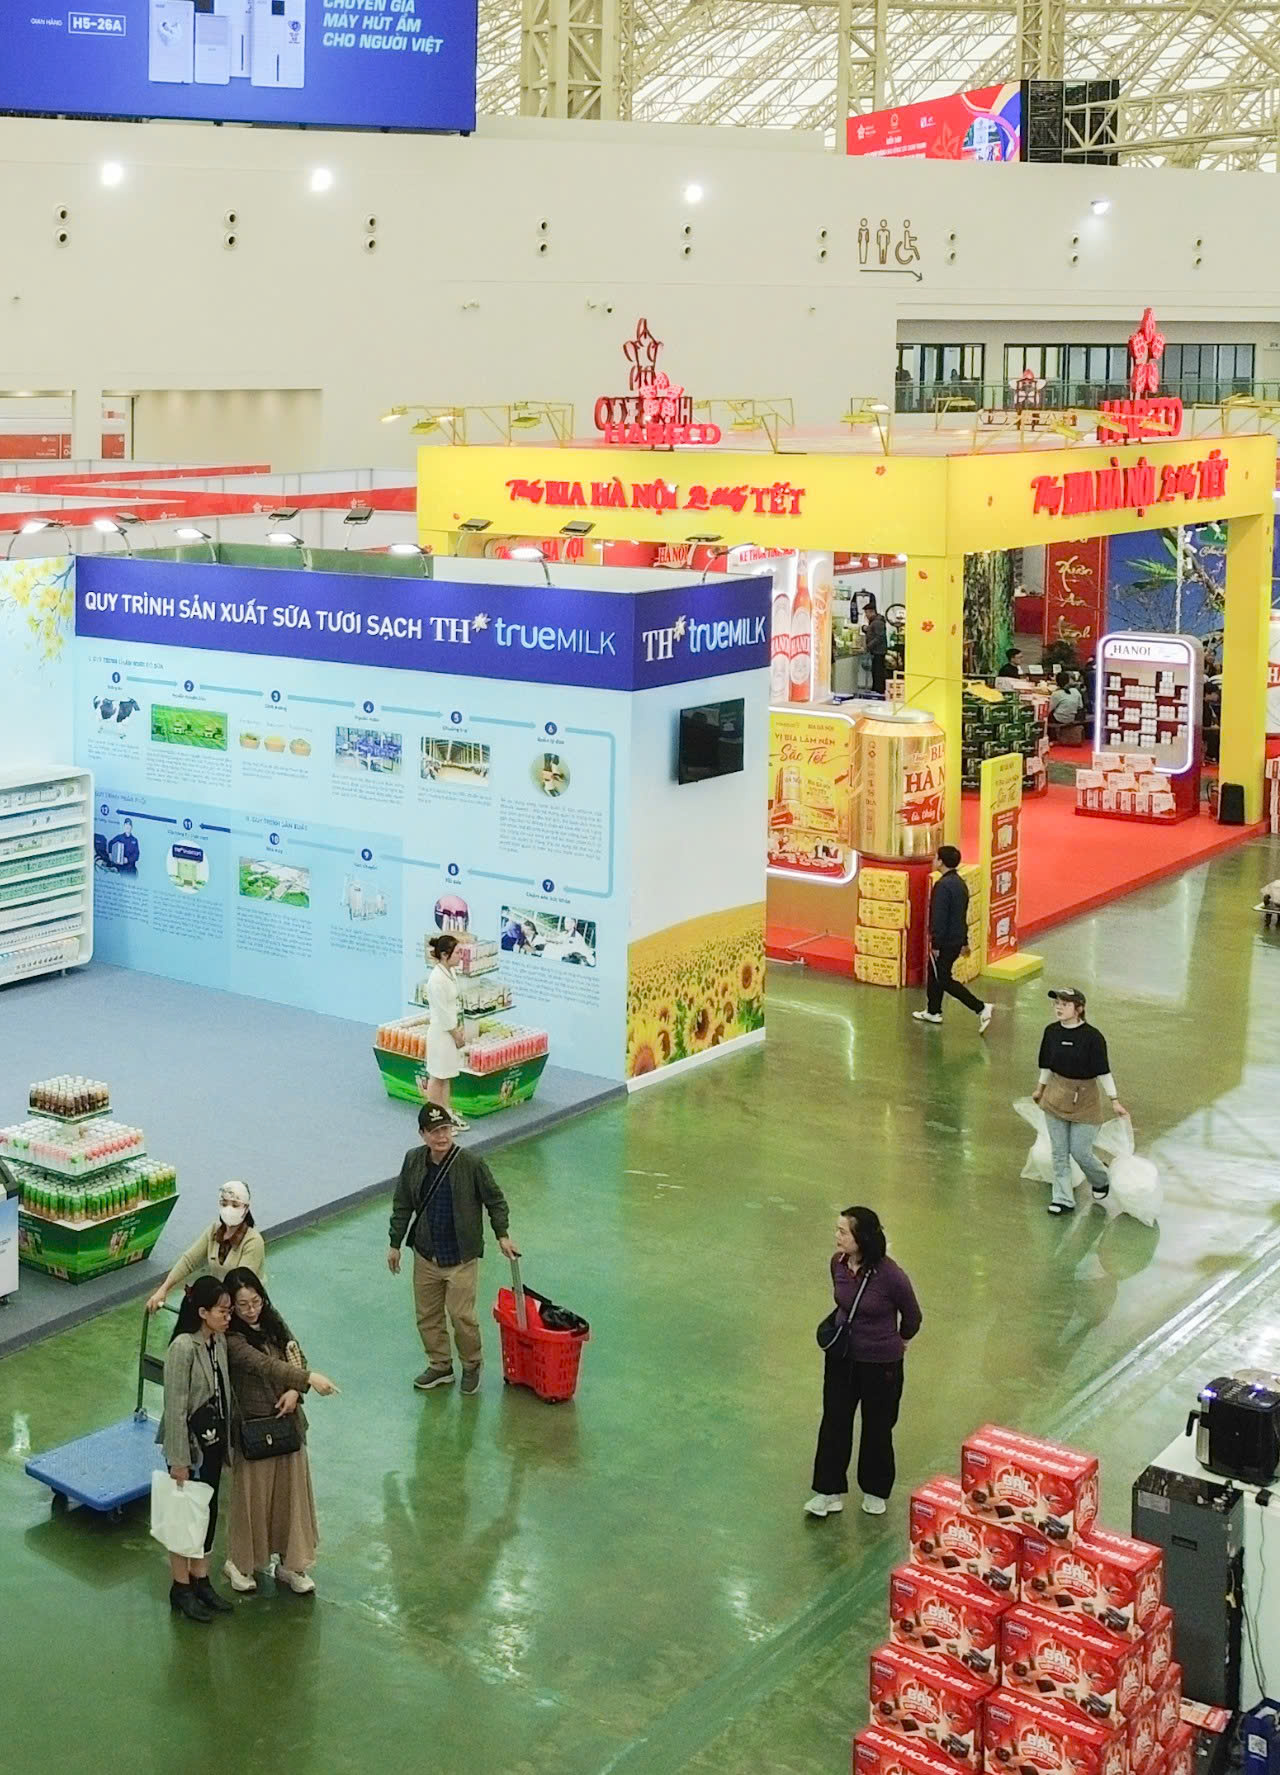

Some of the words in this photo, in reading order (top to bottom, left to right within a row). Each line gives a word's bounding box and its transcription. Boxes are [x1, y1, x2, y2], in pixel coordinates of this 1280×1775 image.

[72, 16, 122, 32] H5-26A
[323, 12, 359, 29] MÁY
[362, 13, 393, 31] HÚT
[323, 32, 355, 48] CHO
[359, 32, 407, 50] NGƯỜI
[411, 36, 444, 55] VIỆT
[749, 481, 806, 515] TẾT
[84, 590, 118, 612] QUY
[121, 591, 174, 617] TRÌNH
[179, 594, 216, 621] SẢN
[220, 598, 268, 626] XUẤT
[272, 603, 312, 630] SỮA
[315, 609, 361, 634] TƯƠI
[367, 615, 422, 641] SẠCH
[429, 616, 471, 644] TH
[642, 627, 674, 662] TH
[904, 764, 935, 793] HÀ
[973, 1439, 1071, 1473] SUNHOUSE
[903, 1568, 993, 1607] SUNHOUSE
[1014, 1608, 1113, 1650] SUNHOUSE
[881, 1649, 973, 1691] SUNHOUSE
[998, 1693, 1098, 1735] SUNHOUSE
[865, 1731, 960, 1775] SUNHOUSE
